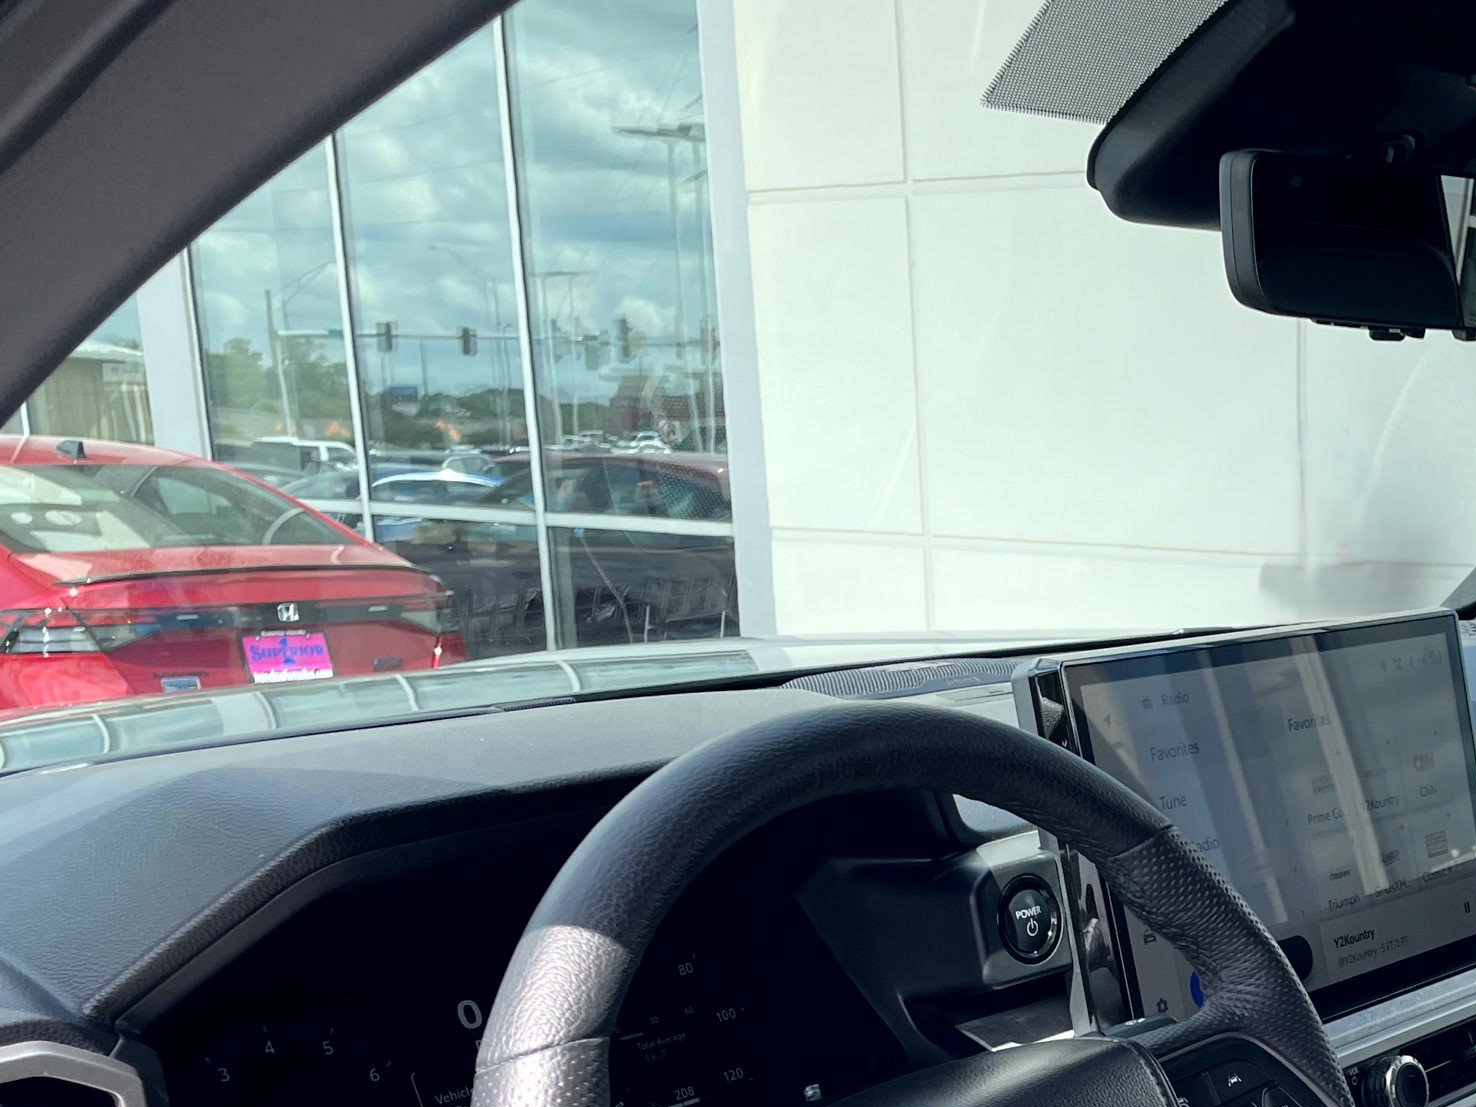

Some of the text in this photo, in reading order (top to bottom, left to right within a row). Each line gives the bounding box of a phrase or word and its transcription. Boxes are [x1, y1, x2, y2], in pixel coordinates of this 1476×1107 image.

[1161, 691, 1190, 706] Radio
[1288, 714, 1331, 732] Favorites
[1150, 742, 1200, 761] Favorites
[1419, 784, 1438, 798] CNN
[1159, 795, 1188, 810] Tune
[1307, 810, 1331, 826] Prime
[1195, 835, 1220, 852] adio
[1375, 878, 1407, 898] SiriusXM
[1328, 894, 1361, 912] Triumph
[1015, 905, 1042, 920] POWER
[1333, 928, 1375, 950] Y2Kountry
[678, 962, 694, 976] 80
[456, 999, 483, 1030] 0
[715, 1007, 736, 1023] 100
[264, 1040, 275, 1054] 4
[321, 1041, 335, 1056] 5
[217, 1067, 231, 1083] 3
[369, 1067, 381, 1082] 6
[723, 1067, 744, 1083] 120
[435, 1087, 471, 1105] Vehicl
[674, 1086, 696, 1101] 208
